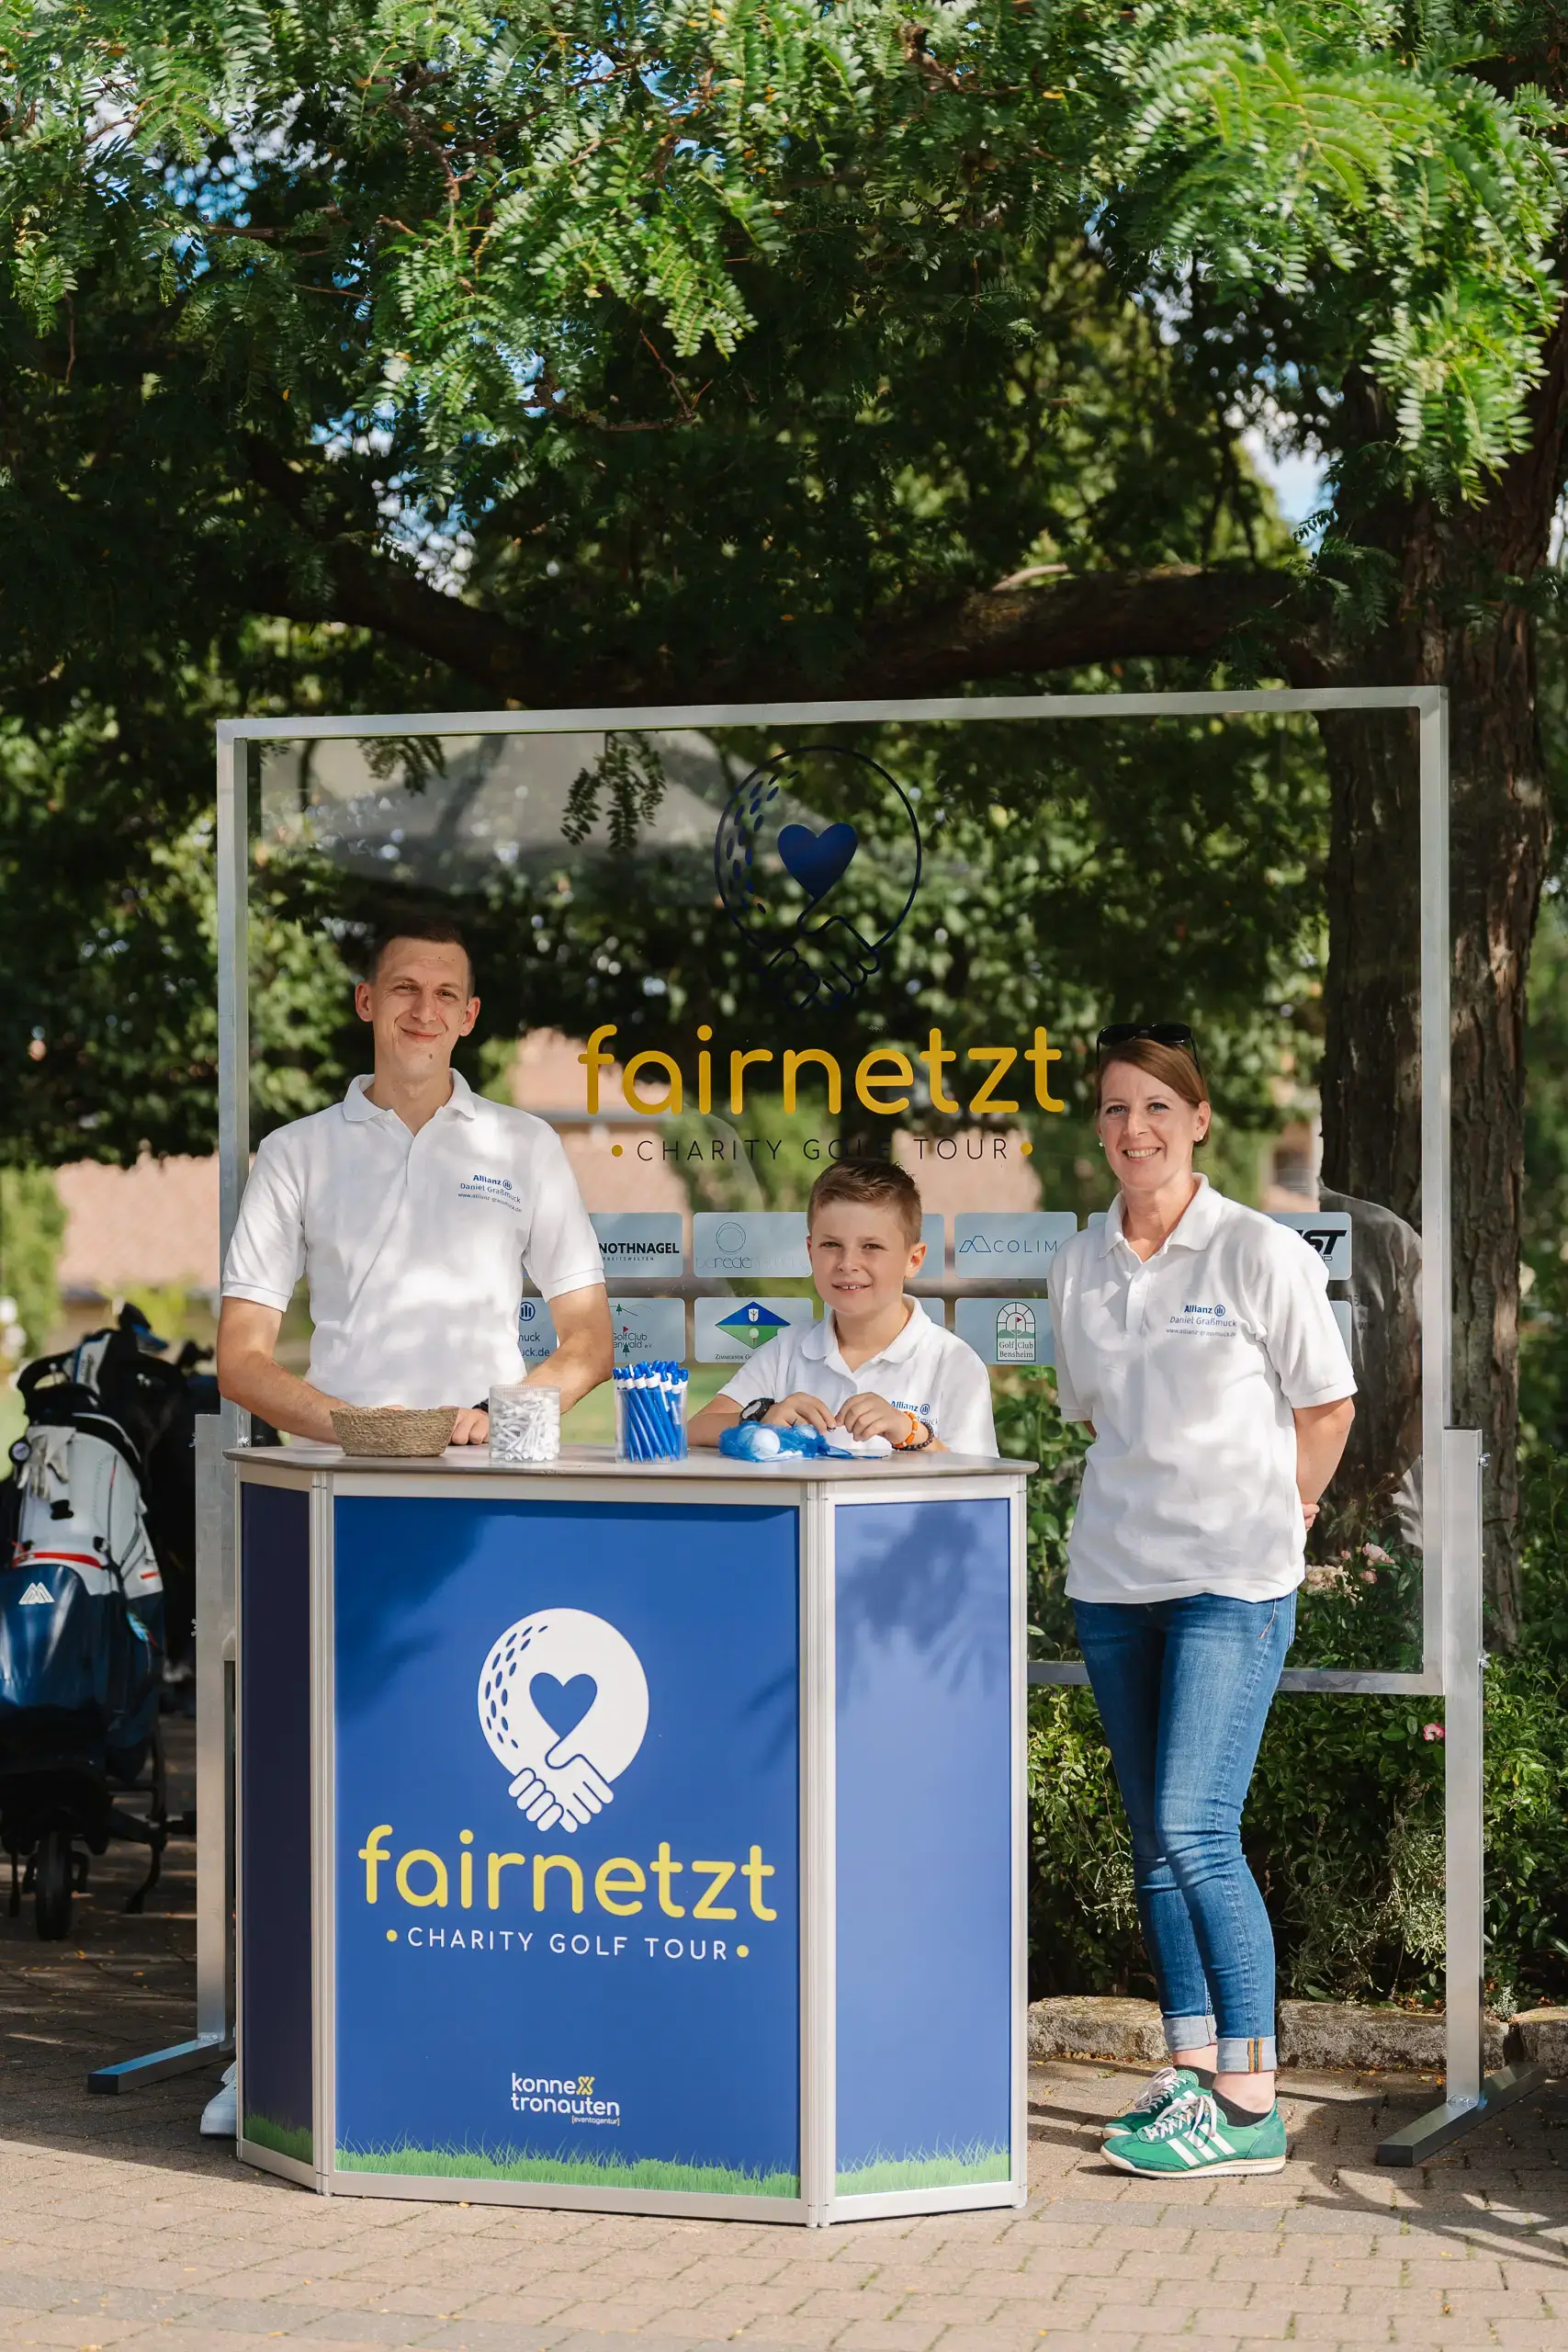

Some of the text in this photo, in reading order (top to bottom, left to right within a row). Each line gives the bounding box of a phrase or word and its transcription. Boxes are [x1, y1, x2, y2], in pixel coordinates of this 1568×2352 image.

[578, 1024, 1065, 1114] fairnetzt
[637, 1138, 783, 1161] CHARITY
[913, 1138, 1008, 1160] TOUR
[472, 1174, 502, 1185] Allianz
[460, 1182, 521, 1204] Daniel Graßmuck
[599, 1242, 680, 1254] NOTHNAGEL
[1184, 1305, 1213, 1314] Allianz
[1169, 1316, 1237, 1327] Daniel Graßmuck
[998, 1340, 1033, 1350] Golf Club
[998, 1351, 1033, 1359] Bensheim
[890, 1400, 919, 1412] Allianz
[358, 1824, 777, 1922] fairnetzt
[407, 1927, 727, 1962] CHARITY GOLF TOUR
[511, 2092, 620, 2117] tronauten
